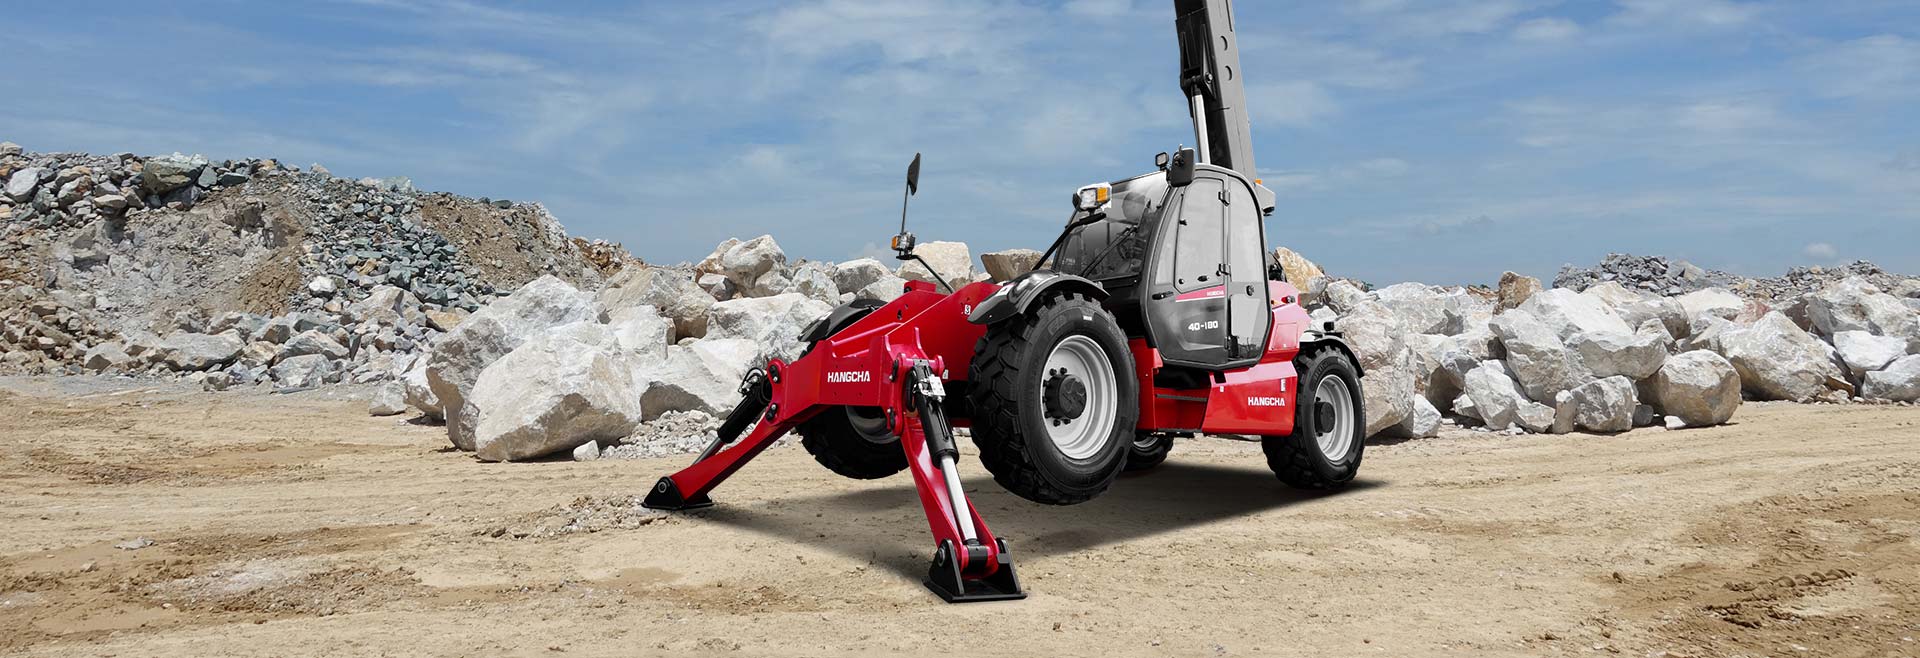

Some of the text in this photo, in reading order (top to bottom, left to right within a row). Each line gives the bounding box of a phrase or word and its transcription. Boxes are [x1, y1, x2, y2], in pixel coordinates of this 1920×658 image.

[1188, 320, 1219, 331] 40-180
[827, 370, 871, 383] HANGCHA
[1247, 396, 1286, 407] HANGCHA
